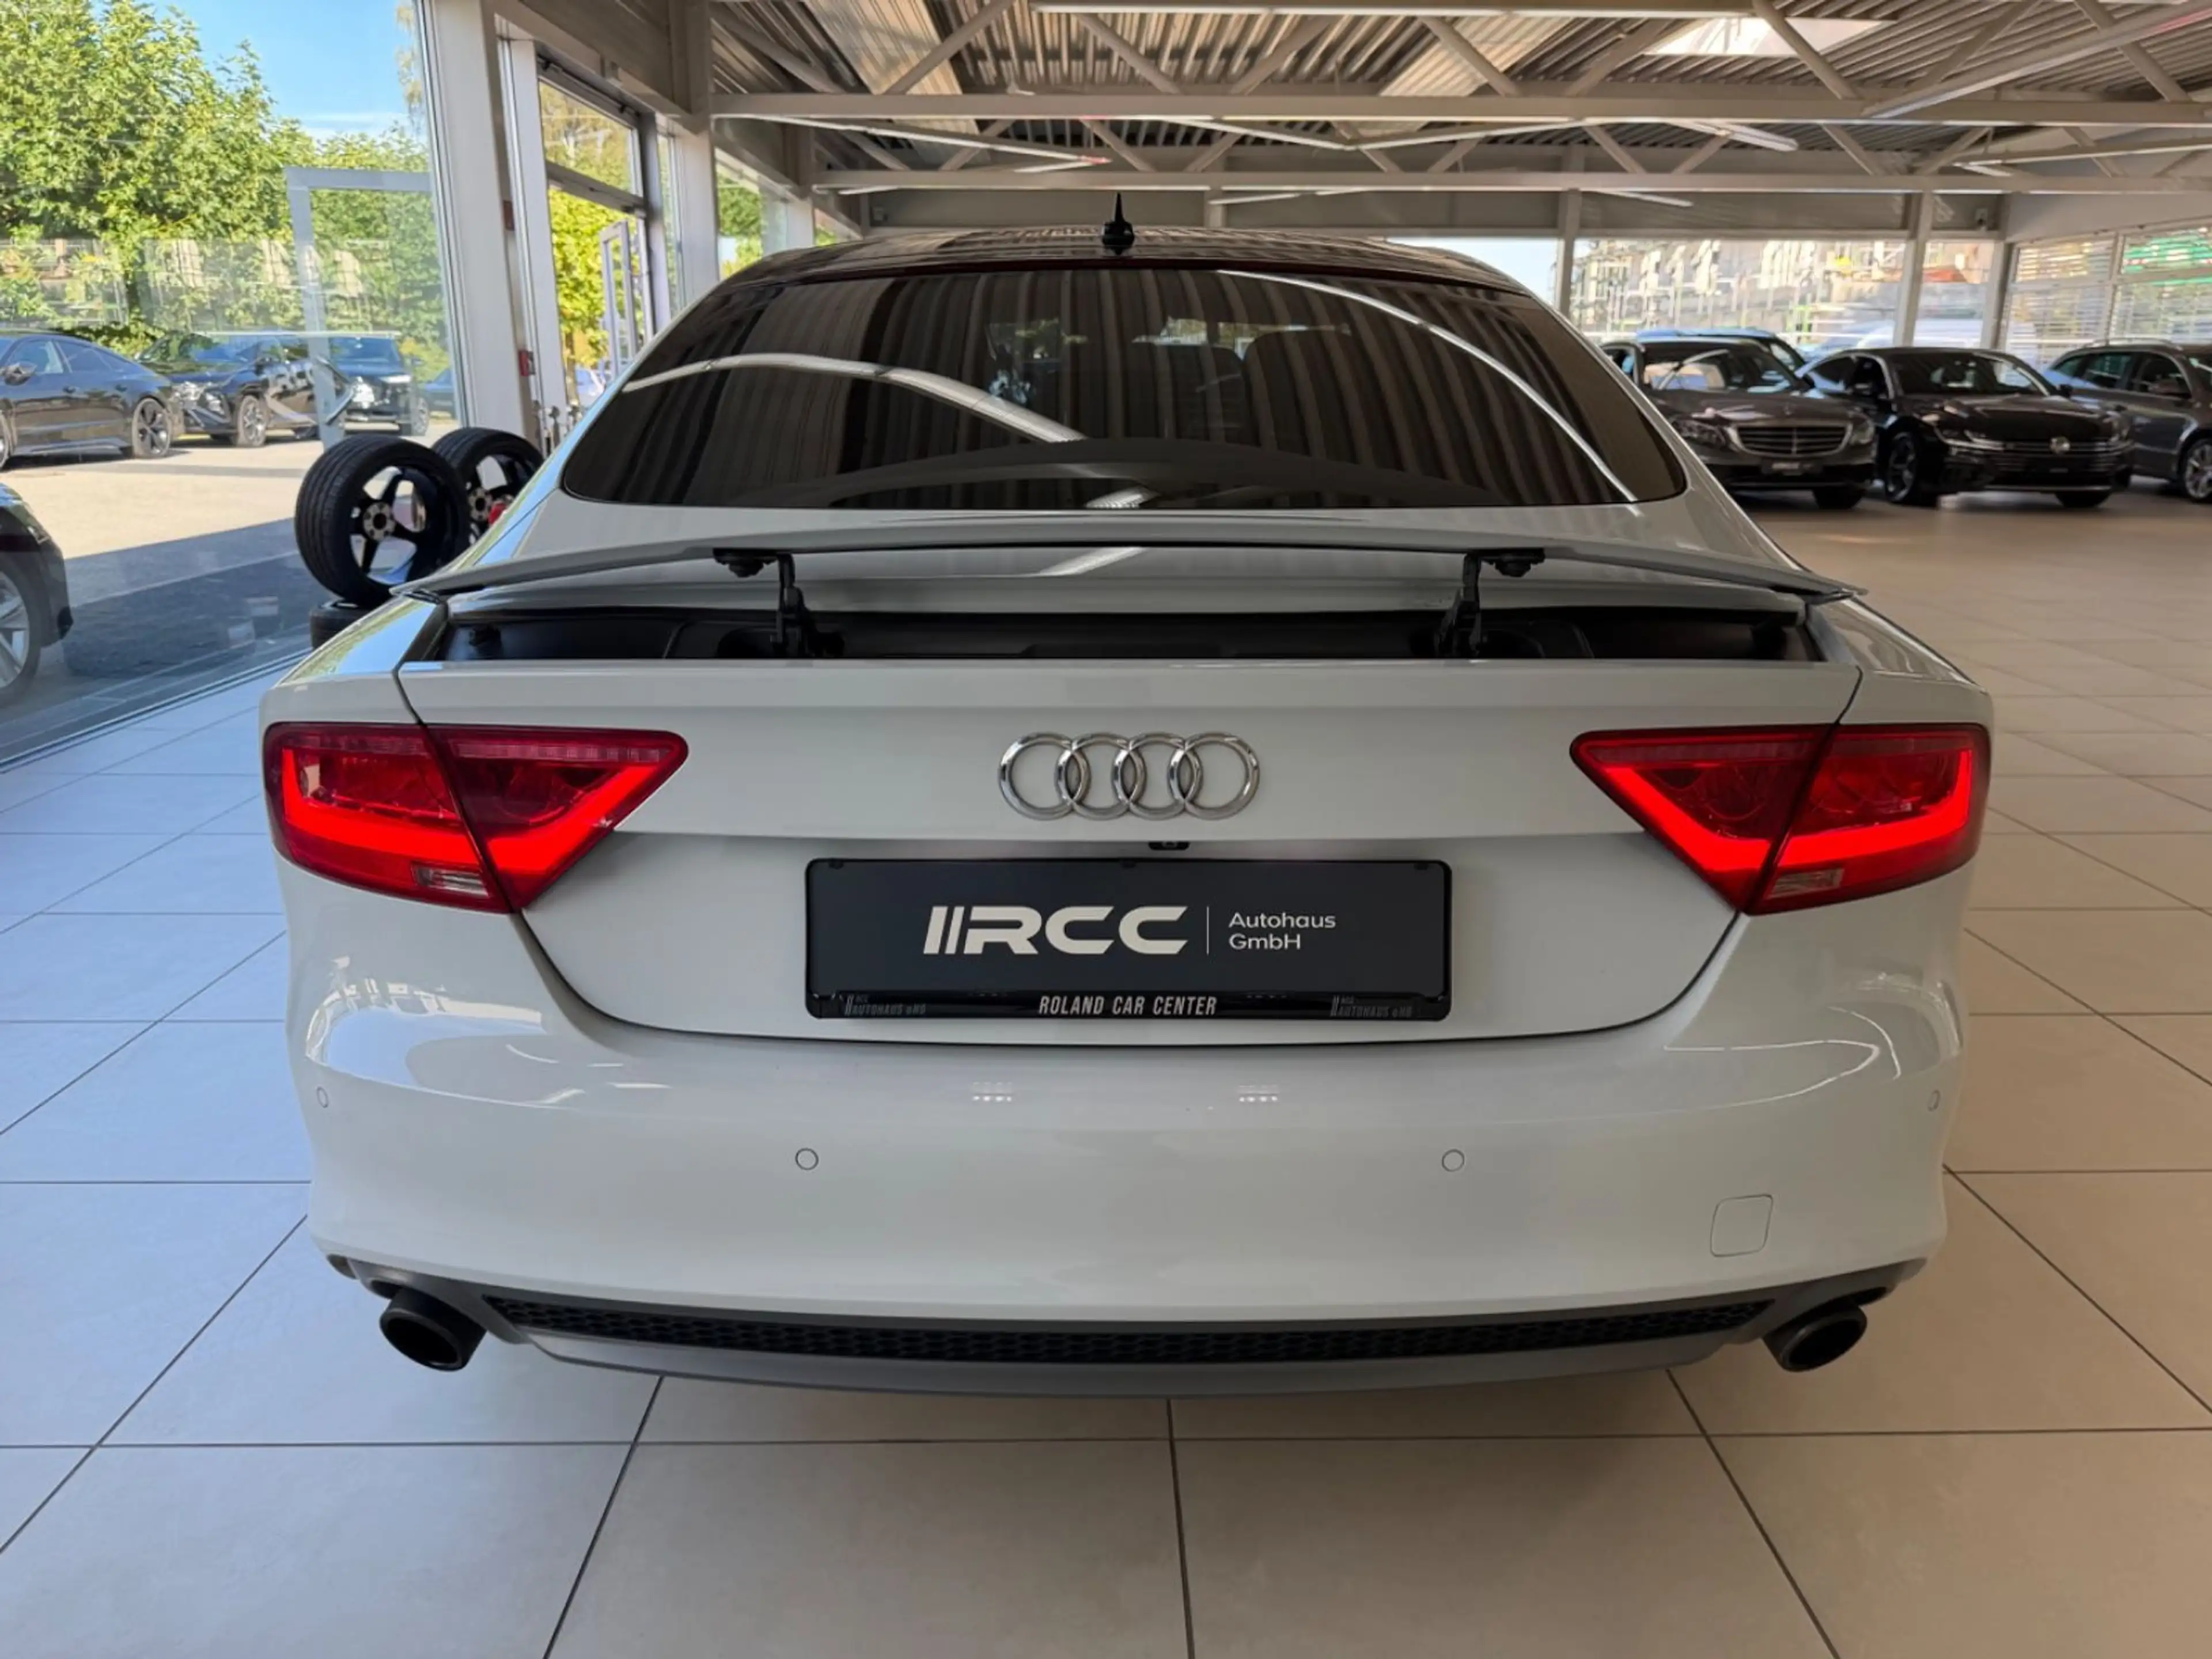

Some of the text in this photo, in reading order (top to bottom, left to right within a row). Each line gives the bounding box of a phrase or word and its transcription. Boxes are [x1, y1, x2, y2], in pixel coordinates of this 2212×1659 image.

[1229, 912, 1336, 929] Autohaus
[1229, 934, 1301, 950] GmbH
[1038, 995, 1218, 1015] ROLAND CAR CENTER
